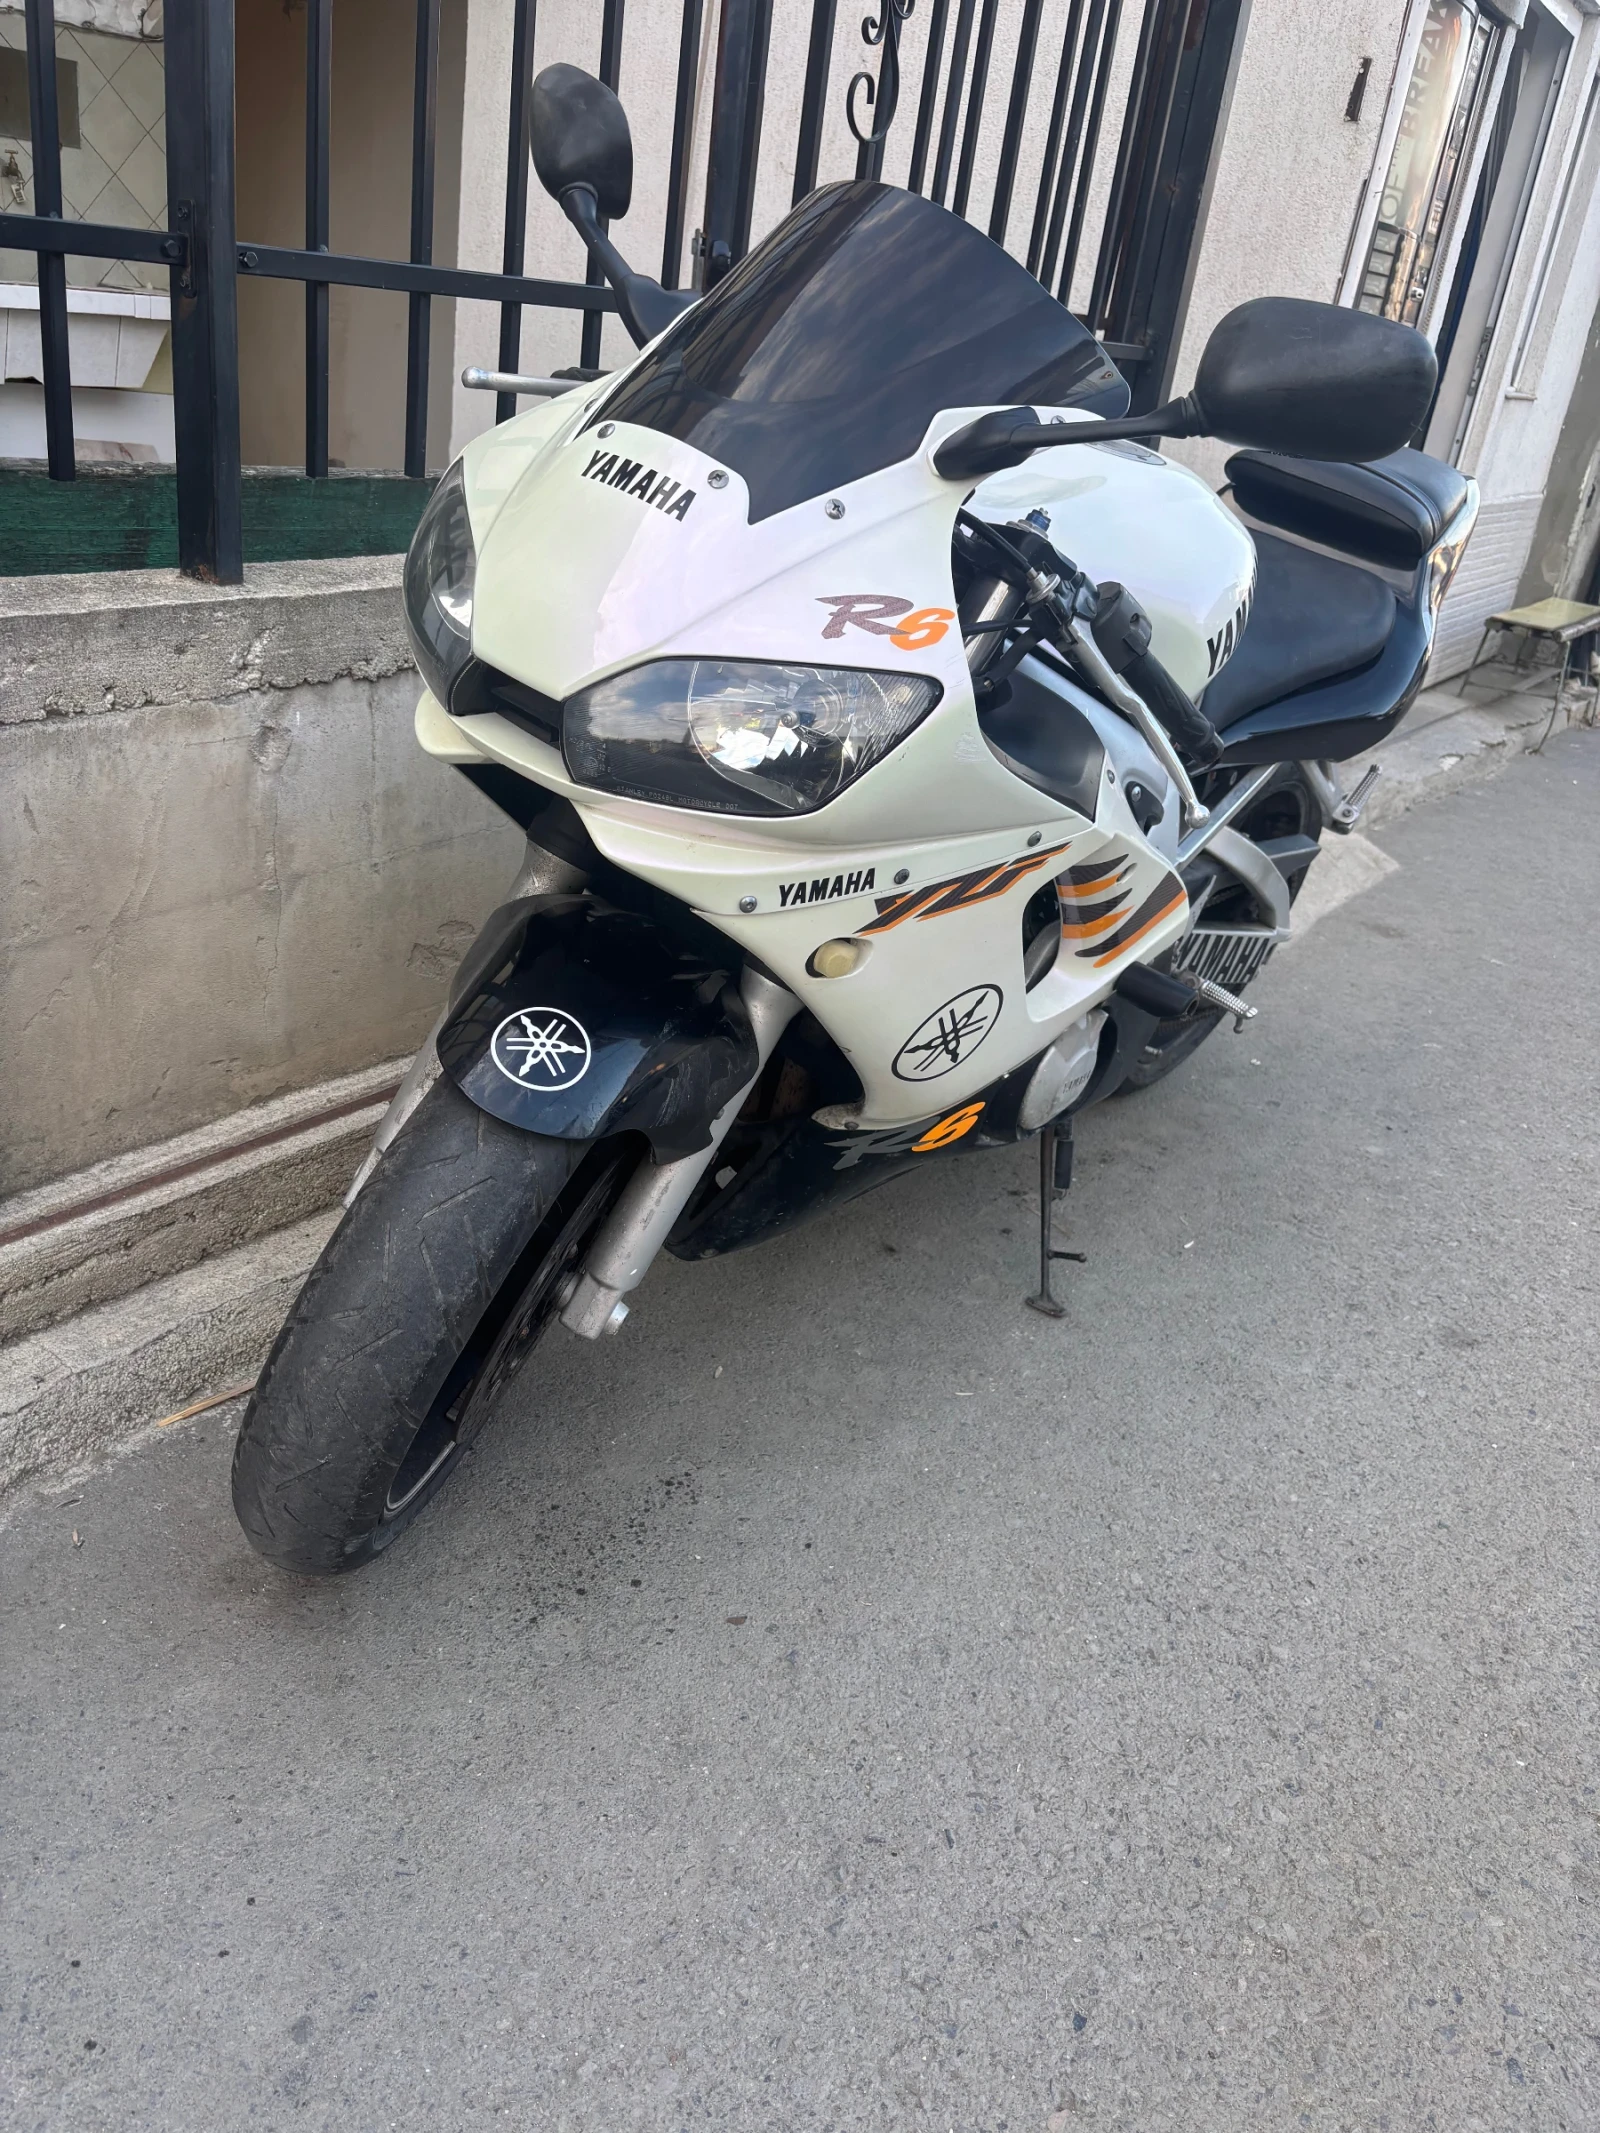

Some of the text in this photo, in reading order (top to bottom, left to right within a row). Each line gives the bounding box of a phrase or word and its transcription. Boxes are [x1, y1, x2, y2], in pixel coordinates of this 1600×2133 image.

[581, 450, 697, 522] YAMAHA
[815, 594, 956, 652] R6
[779, 867, 876, 907] YAMAHA
[1176, 933, 1271, 983] YAMAHA
[824, 1102, 986, 1170] R6
